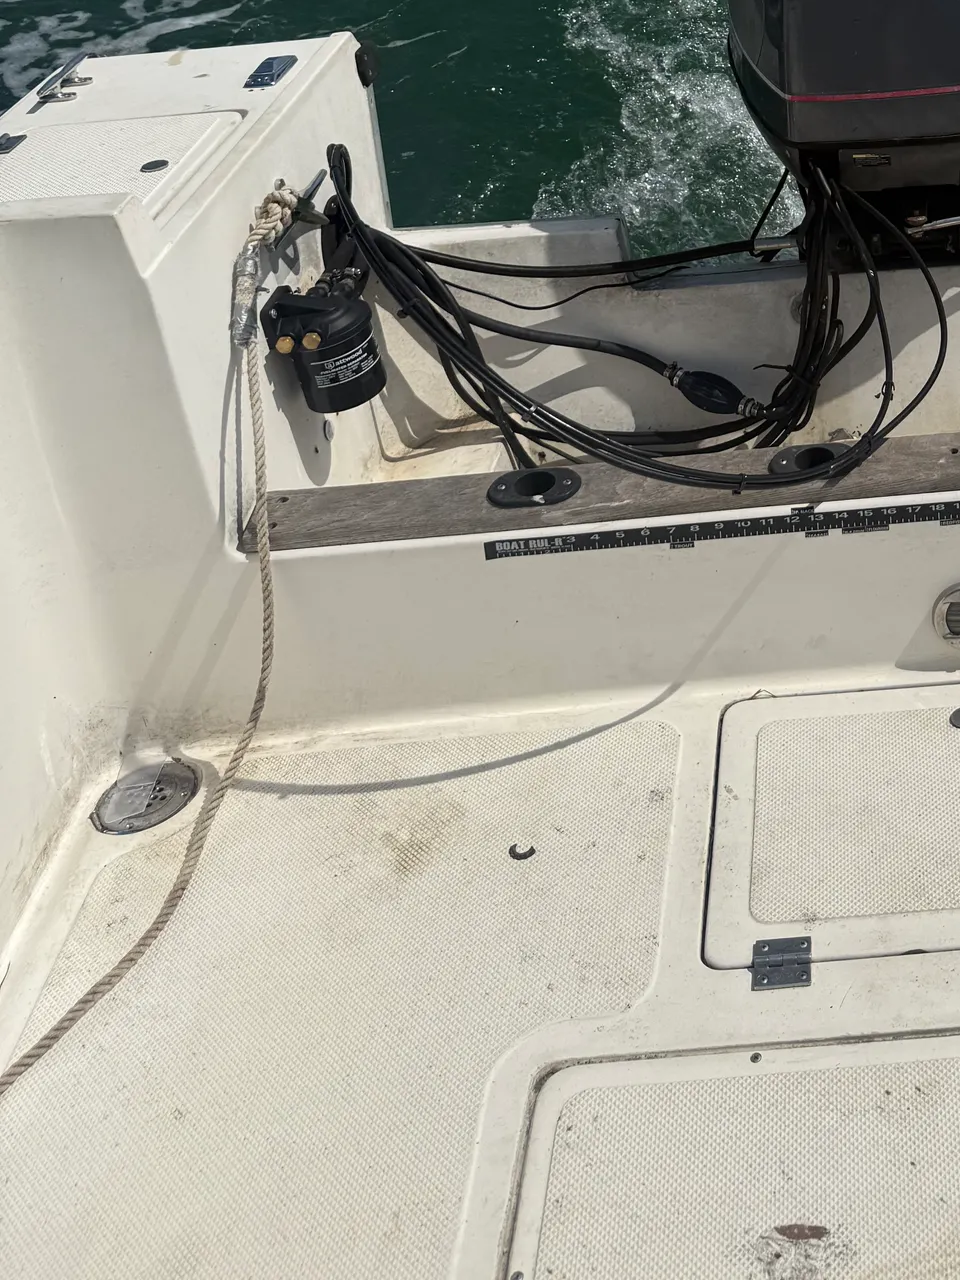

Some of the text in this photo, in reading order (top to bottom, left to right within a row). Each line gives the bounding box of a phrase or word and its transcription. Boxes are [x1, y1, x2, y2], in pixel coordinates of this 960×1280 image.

[640, 528, 650, 536] 6
[666, 526, 676, 534] 7
[714, 522, 724, 530] 9
[734, 520, 751, 528] 10
[759, 518, 774, 526] 11
[881, 507, 897, 515] 16
[495, 540, 526, 551] BOAT
